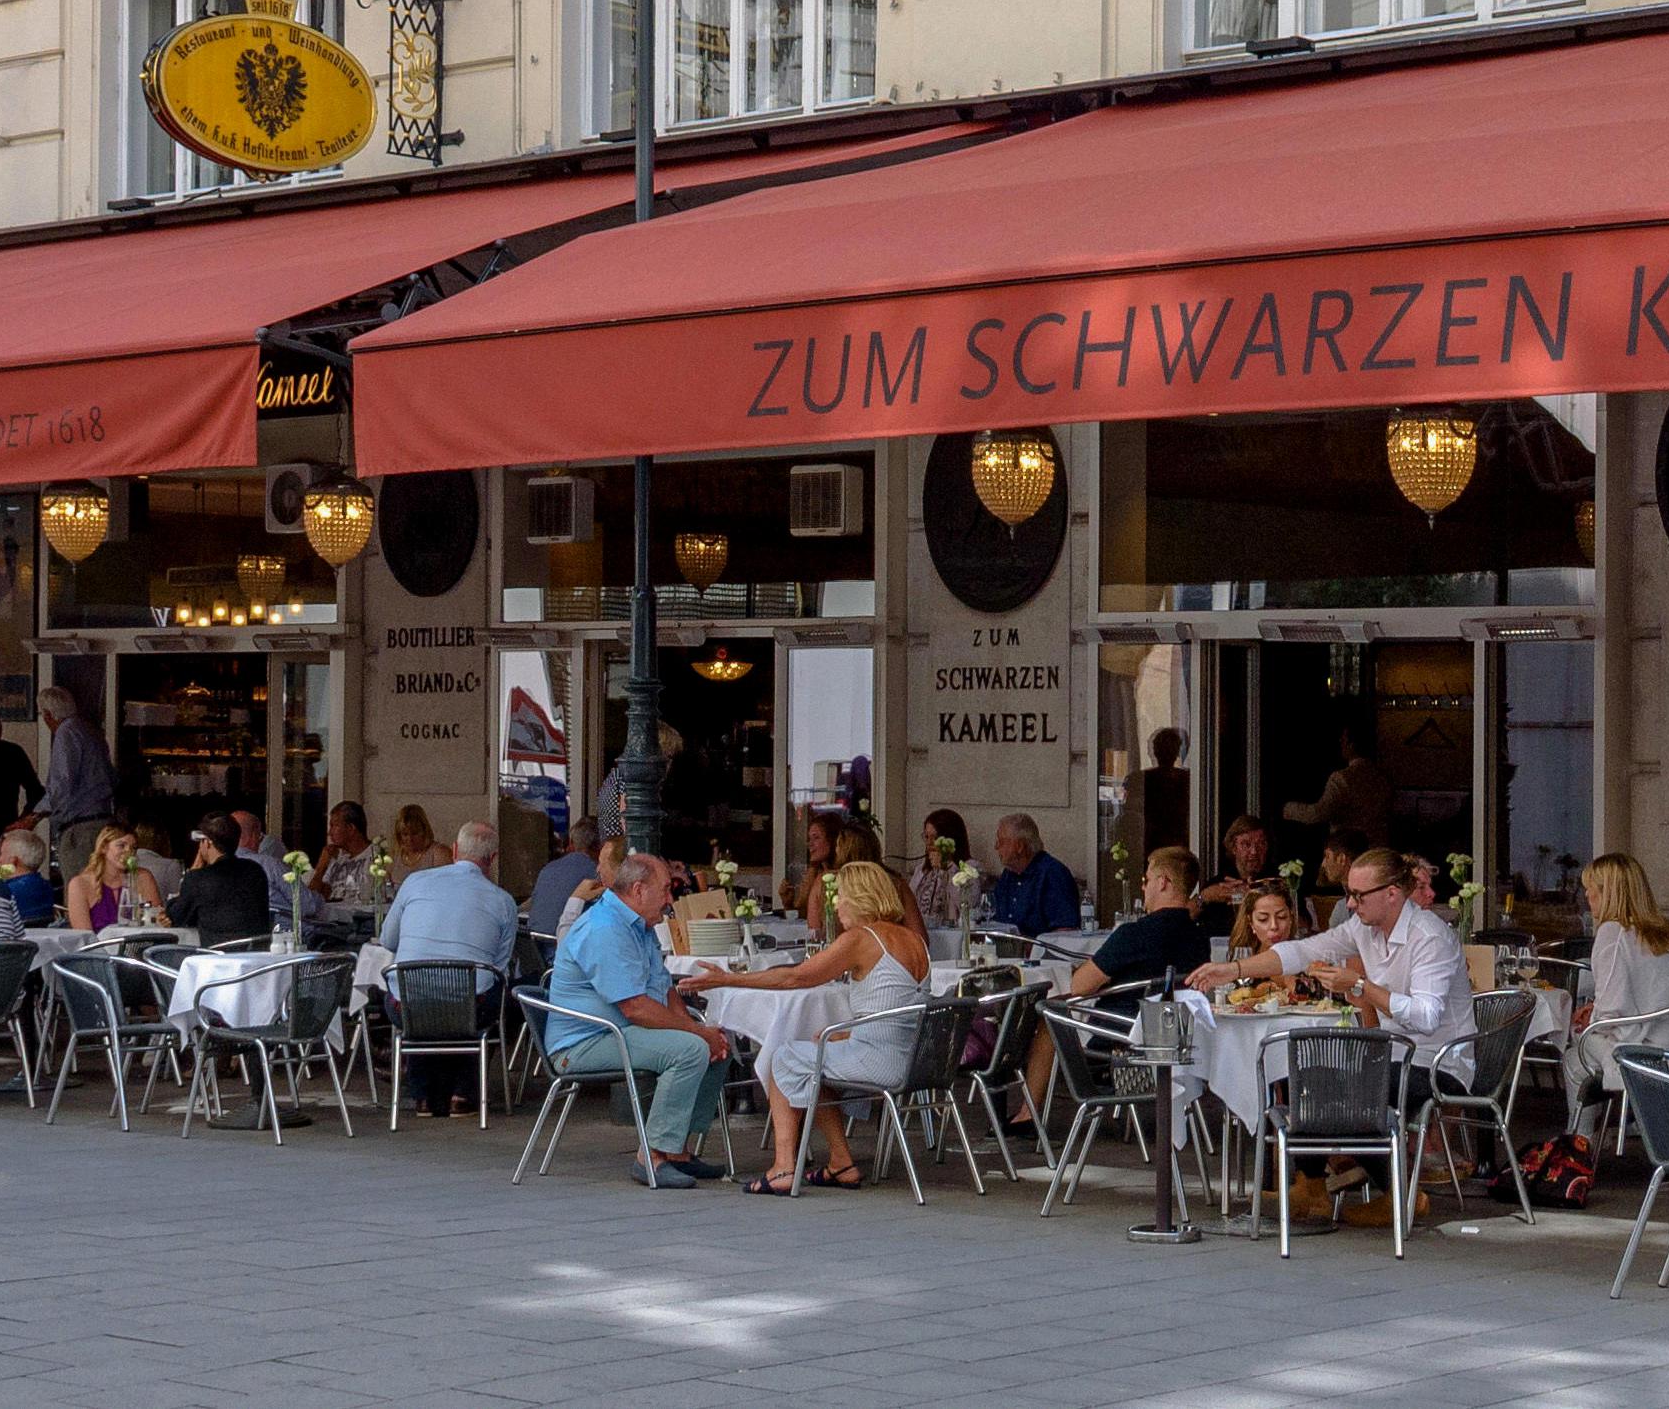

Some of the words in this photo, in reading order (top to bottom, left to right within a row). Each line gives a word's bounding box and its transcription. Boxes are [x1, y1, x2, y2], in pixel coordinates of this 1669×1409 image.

[251, 0, 268, 12] seit
[269, 0, 291, 18] 1618
[174, 25, 236, 60] Restaurant
[252, 25, 272, 39] und
[288, 28, 361, 89] Weinhandlung
[746, 326, 928, 418] ZUM
[959, 271, 1573, 400] SCHWARZEN
[46, 405, 106, 445] 1618
[386, 626, 476, 648] BOUTILLIER
[972, 628, 1020, 647] ZUM
[935, 665, 1060, 690] SCHWARZEN
[400, 723, 460, 740] COGNAC
[938, 712, 1059, 743] KAMEEL
